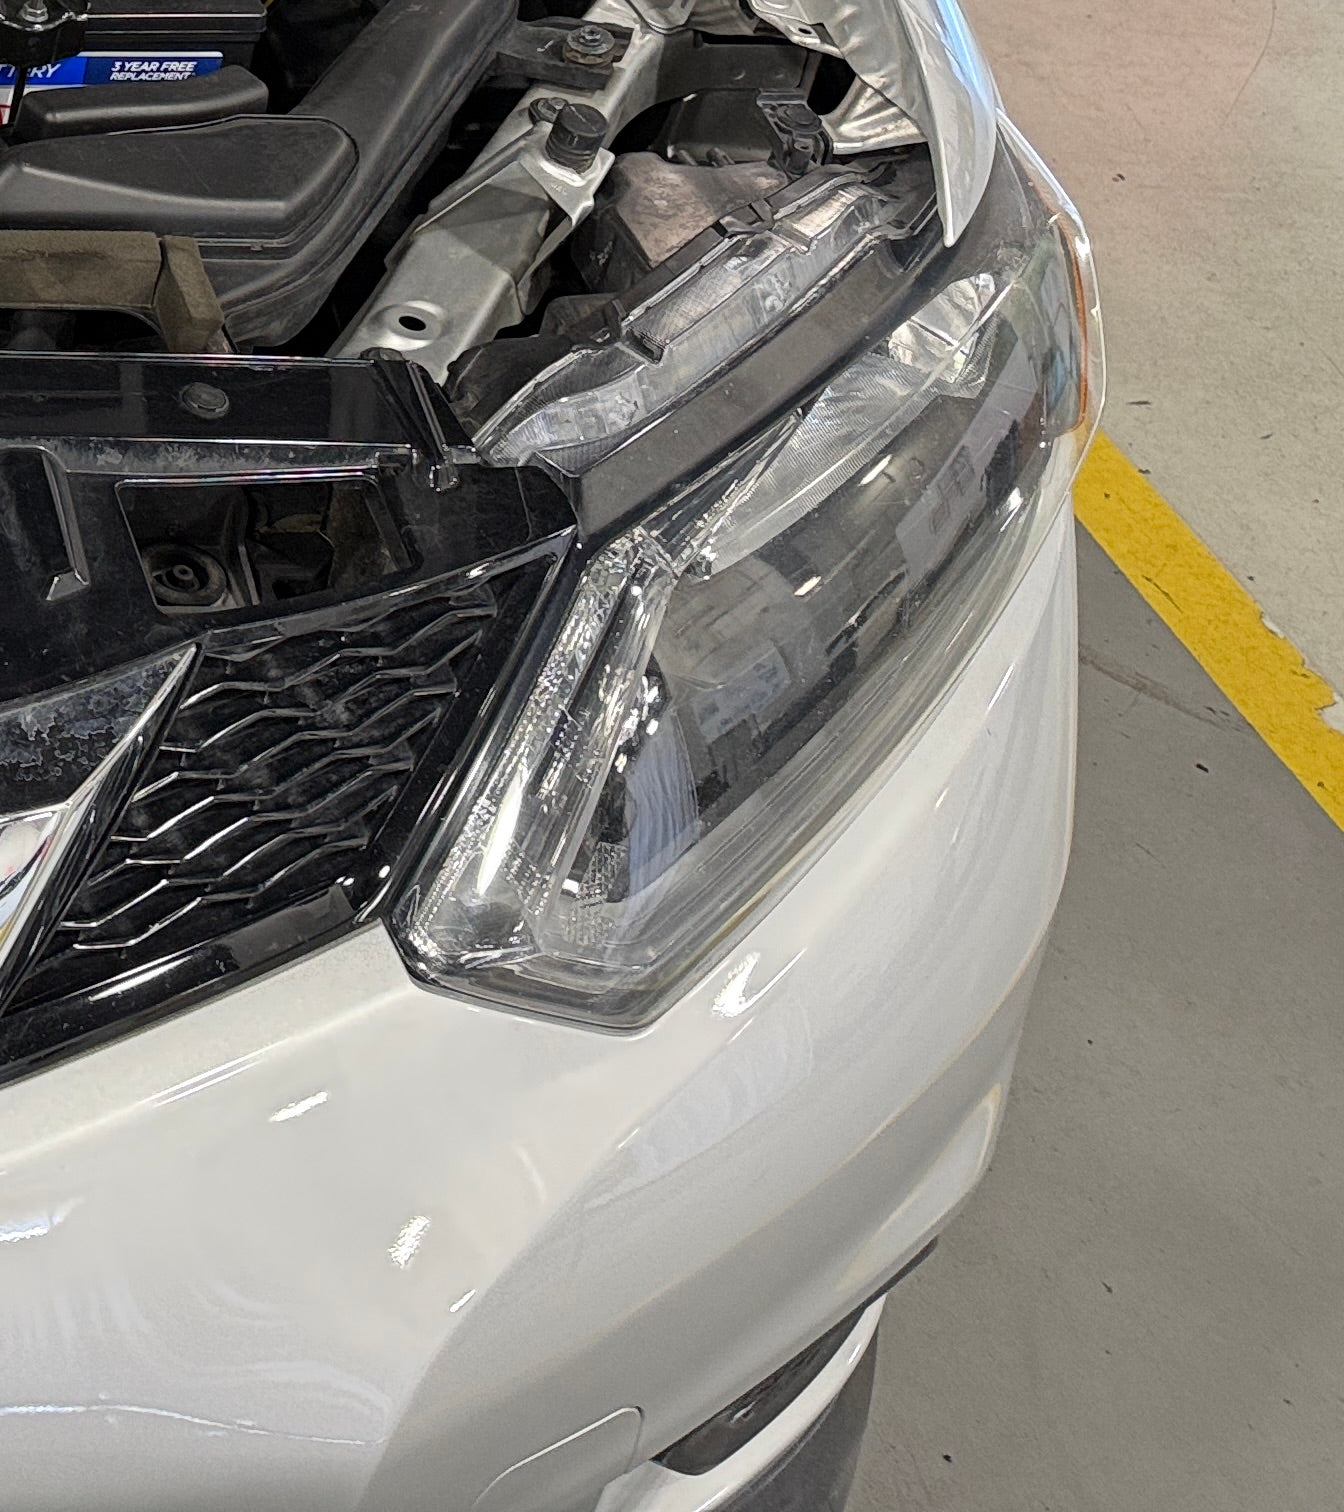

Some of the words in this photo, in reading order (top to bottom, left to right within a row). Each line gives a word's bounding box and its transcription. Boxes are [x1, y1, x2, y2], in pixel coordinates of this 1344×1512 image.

[112, 61, 123, 72] 3
[124, 61, 160, 72] YEAR
[160, 61, 198, 72] FREE
